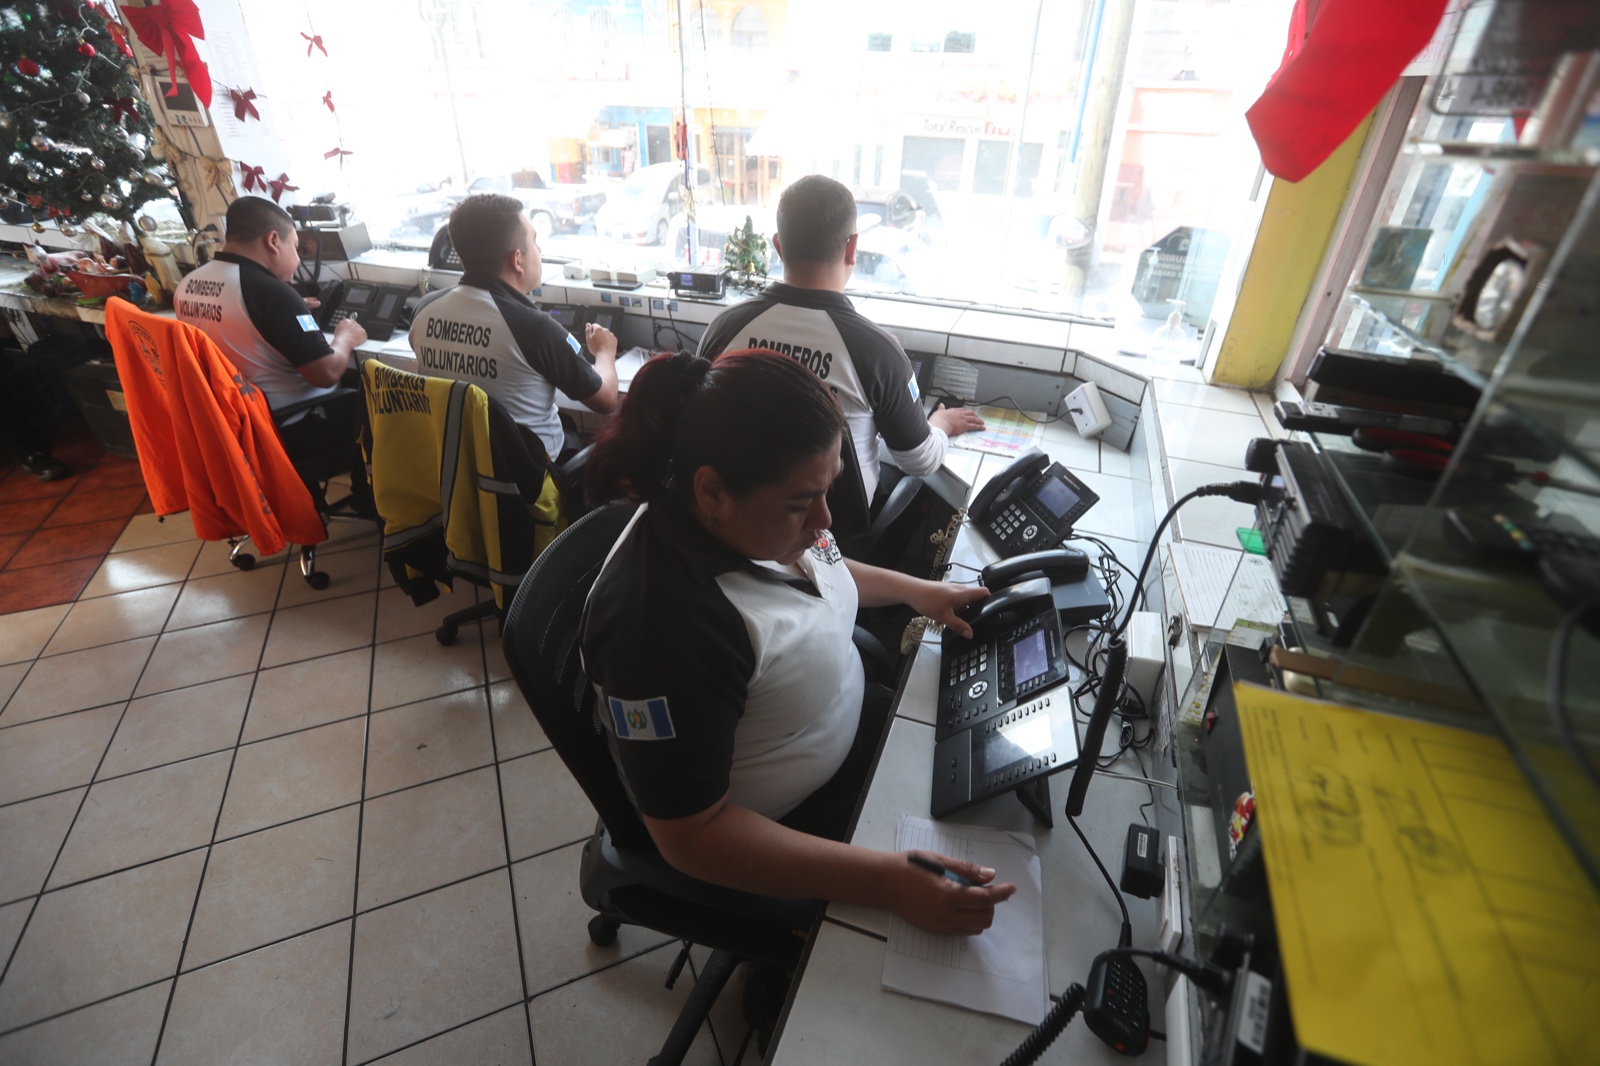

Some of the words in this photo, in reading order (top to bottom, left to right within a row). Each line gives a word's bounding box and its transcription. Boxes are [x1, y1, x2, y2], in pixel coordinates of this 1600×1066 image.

[185, 279, 224, 297] BOMBEROS
[179, 299, 223, 324] VOLUNTARIOS
[426, 317, 491, 348] BOMBEROS
[420, 346, 498, 379] VOLUNTARIOS
